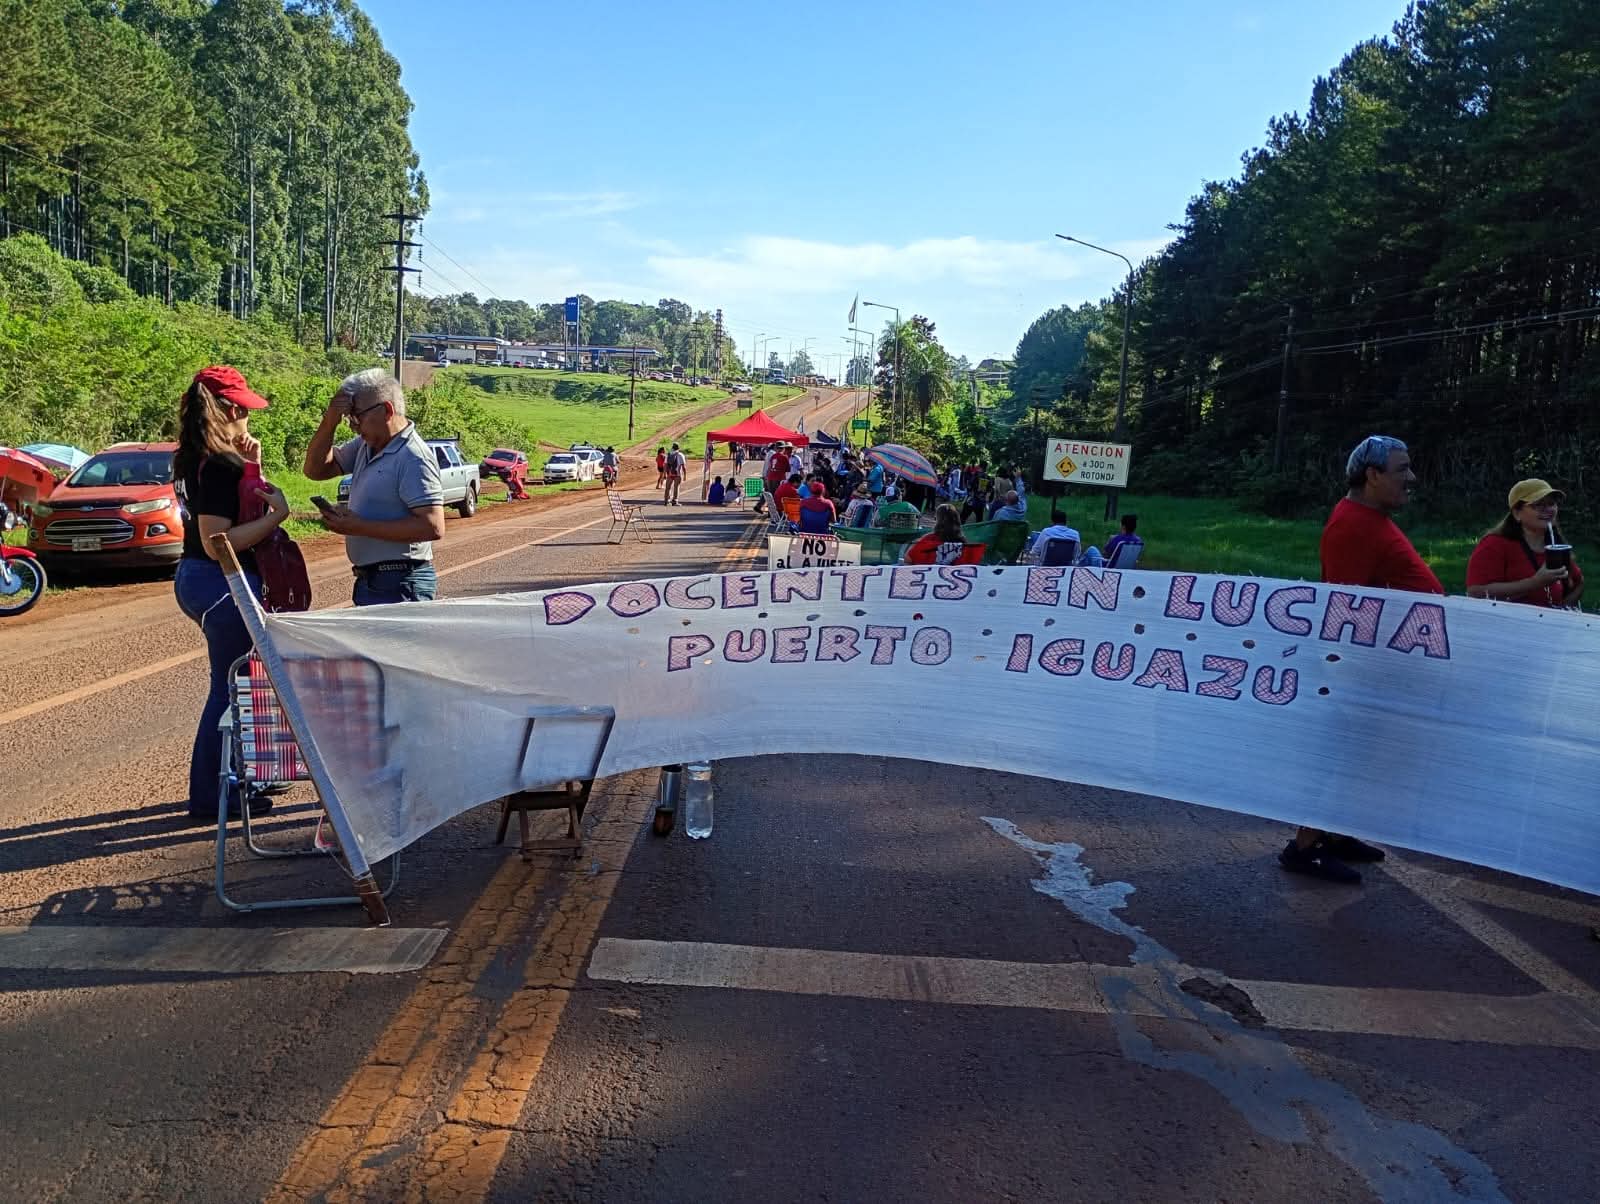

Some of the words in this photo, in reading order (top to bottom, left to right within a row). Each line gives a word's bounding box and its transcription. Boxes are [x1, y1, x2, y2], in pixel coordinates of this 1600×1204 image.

[1054, 443, 1124, 458] ATENCION
[1089, 460, 1105, 469] 300
[1080, 471, 1114, 481] ROTONDA
[802, 538, 826, 556] NO
[543, 566, 978, 625] DOCENTES
[1023, 567, 1122, 611] EN
[1164, 575, 1451, 660] LUCHA
[667, 625, 953, 672] PUERTO
[1005, 633, 1300, 706] IGUAZÚ
